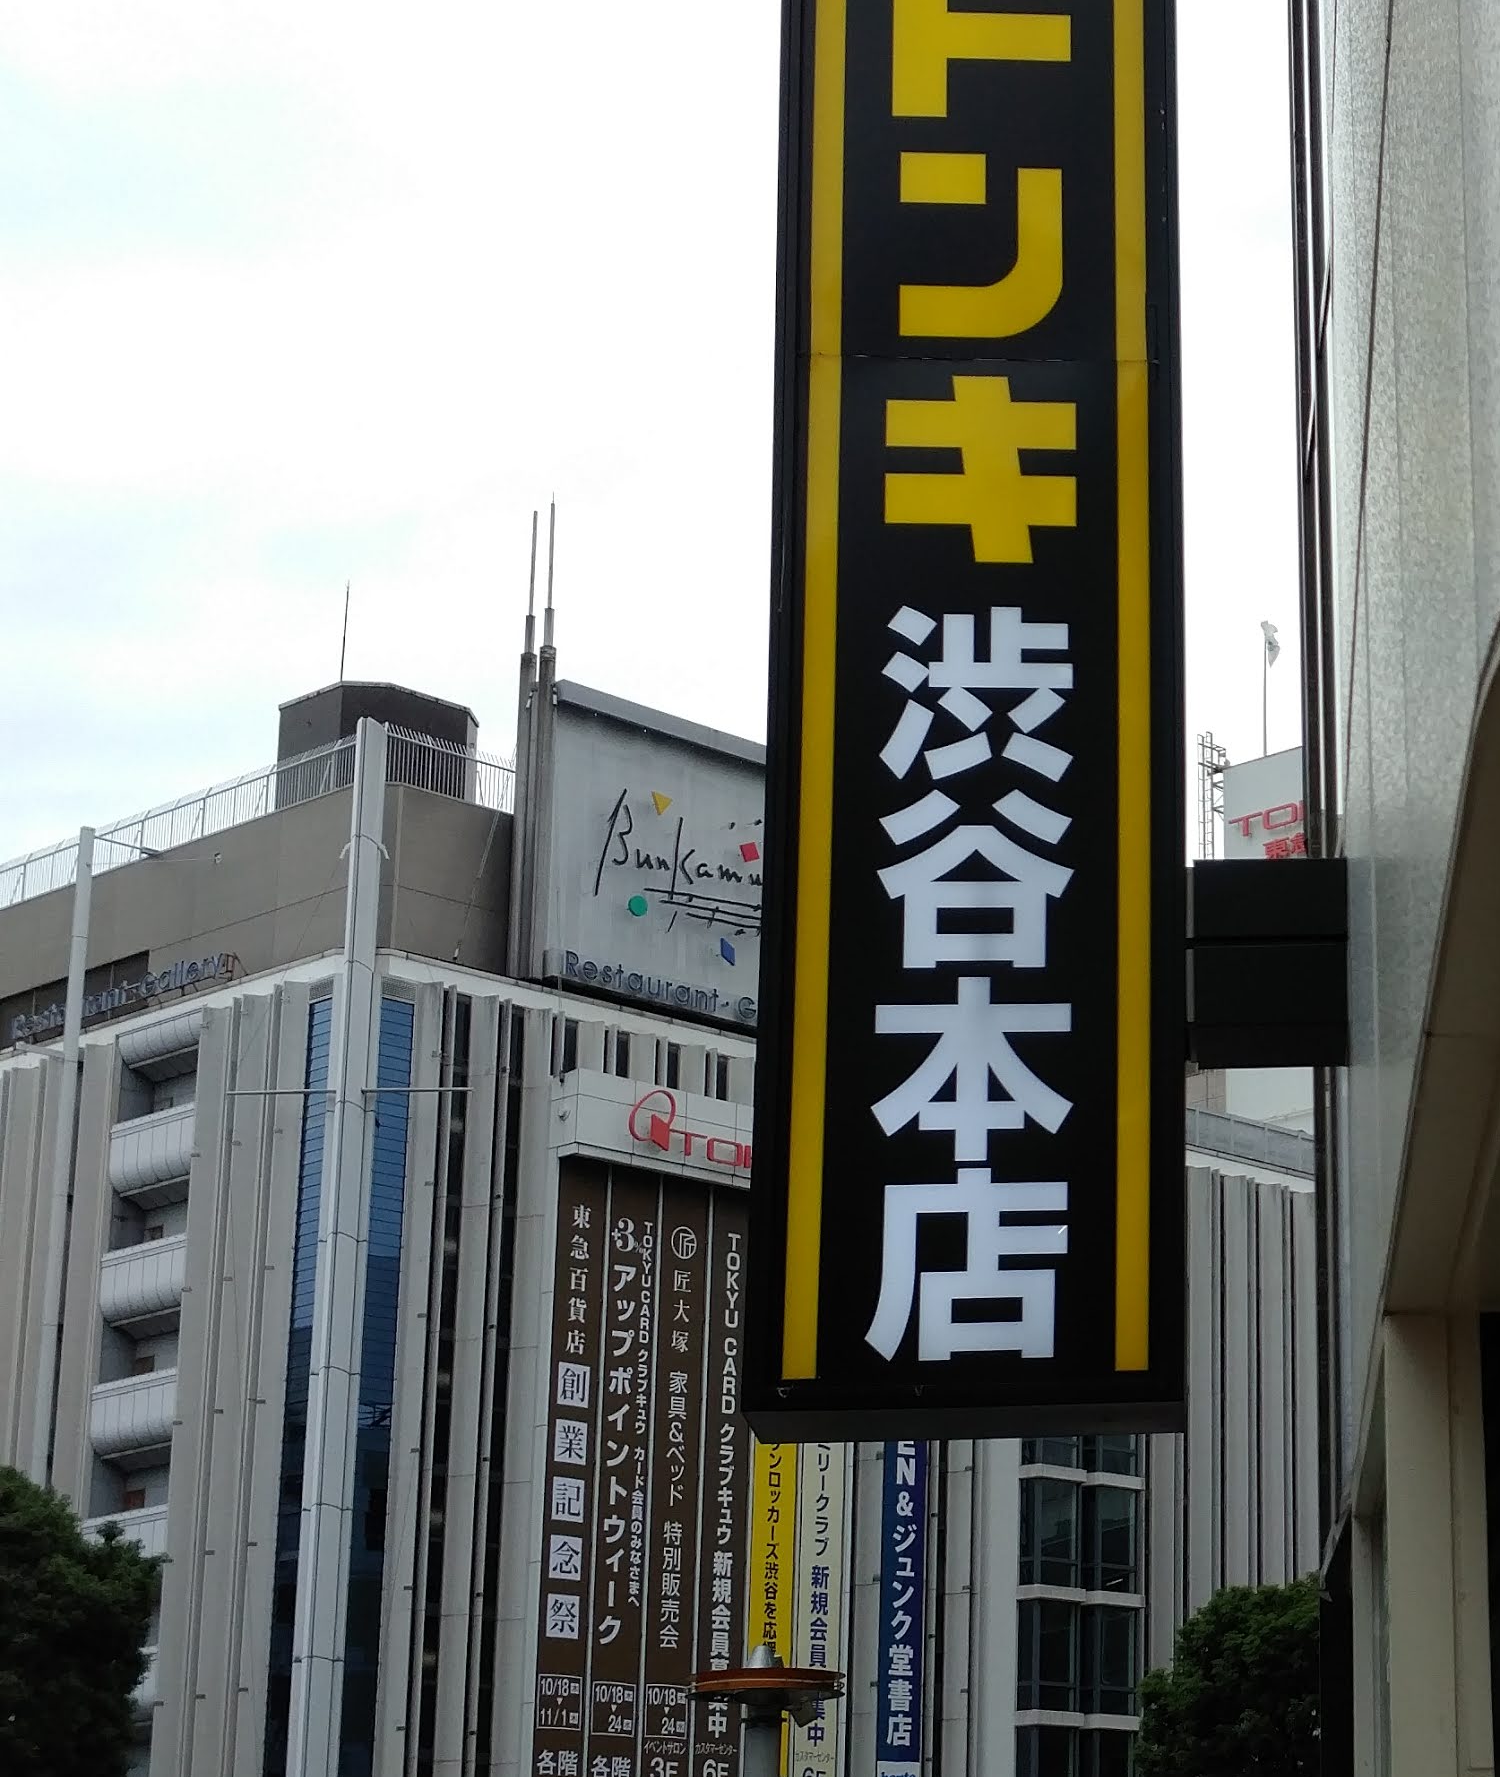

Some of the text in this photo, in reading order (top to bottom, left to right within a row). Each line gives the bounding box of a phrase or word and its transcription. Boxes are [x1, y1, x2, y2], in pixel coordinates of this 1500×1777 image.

[865, 606, 1074, 1364] 渋谷本店
[641, 1221, 654, 1288] TOKYU
[724, 1232, 742, 1329] TOKYU
[638, 1291, 651, 1344] CARD
[671, 1269, 692, 1353] 匠大塚
[721, 1337, 738, 1415] CARD
[547, 1202, 593, 1635] 東急百貨店 創業記念祭
[598, 1264, 637, 1646] アップポイントウィーク
[714, 1422, 736, 1544] クラブキュウ
[895, 1490, 915, 1517] &
[659, 1520, 684, 1650] 特別販売会
[886, 1523, 918, 1749] ジュンク堂書店
[540, 1678, 569, 1696] 10/18
[540, 1708, 567, 1726] 11/1
[595, 1685, 623, 1703] 10/18
[647, 1687, 676, 1706] 10/18
[608, 1715, 622, 1732] 24
[661, 1717, 675, 1734] 24
[536, 1749, 579, 1777] 各階
